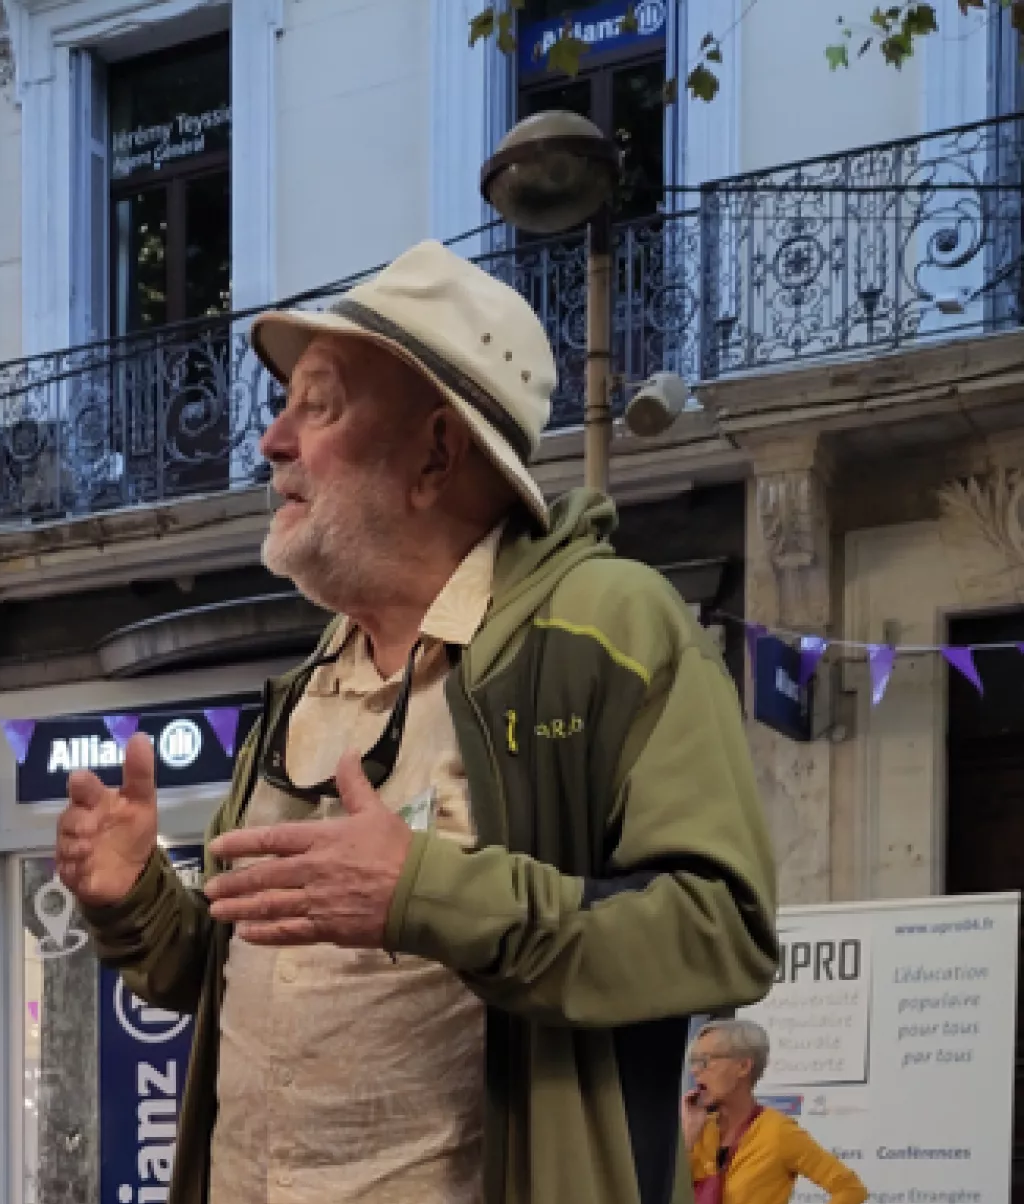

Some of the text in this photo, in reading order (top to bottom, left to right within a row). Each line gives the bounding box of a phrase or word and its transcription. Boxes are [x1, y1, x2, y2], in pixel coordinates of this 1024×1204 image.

[47, 734, 154, 773] Allia
[898, 993, 981, 1014] populaire
[897, 1020, 981, 1040] pour tous
[901, 1048, 973, 1068] par tous
